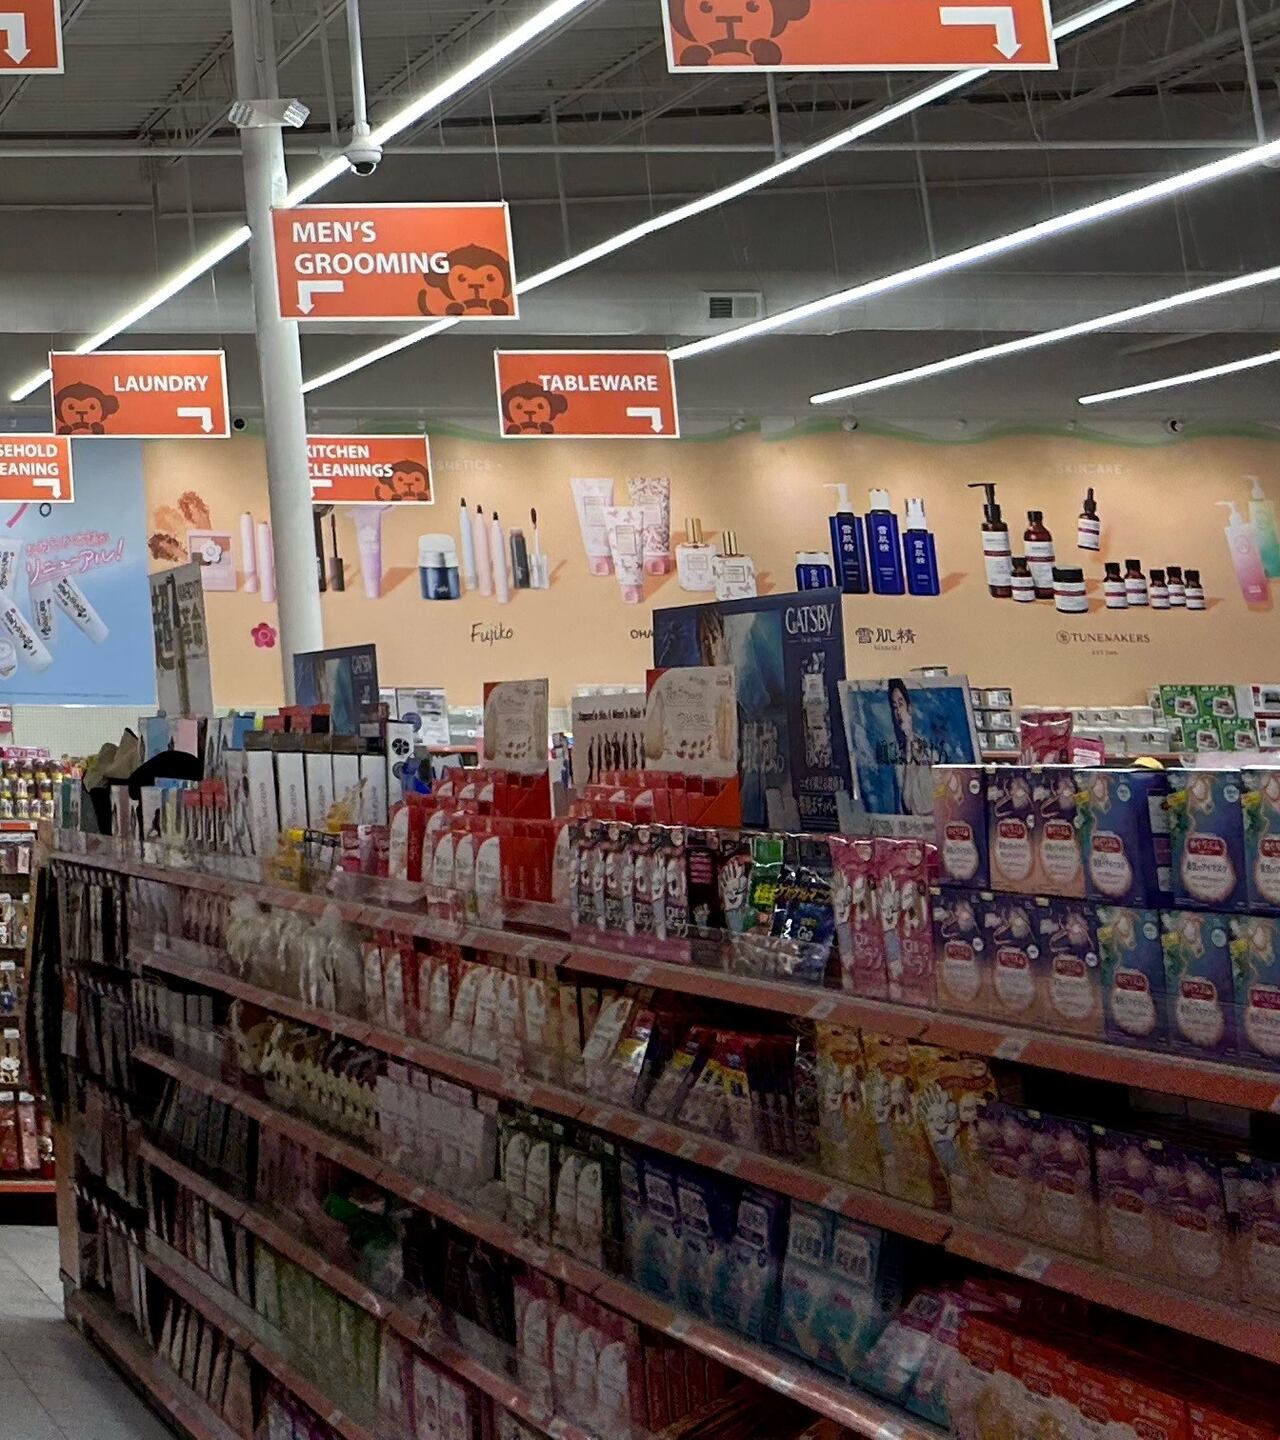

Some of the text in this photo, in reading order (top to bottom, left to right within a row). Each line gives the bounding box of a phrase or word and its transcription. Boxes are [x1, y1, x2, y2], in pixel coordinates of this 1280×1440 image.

[292, 221, 376, 244] MEN'S
[294, 252, 450, 276] GROOMING
[114, 374, 209, 393] LAUNDRY
[539, 373, 658, 393] TABLEWARE
[785, 604, 834, 636] GATSBY
[470, 623, 514, 646] Fujiko
